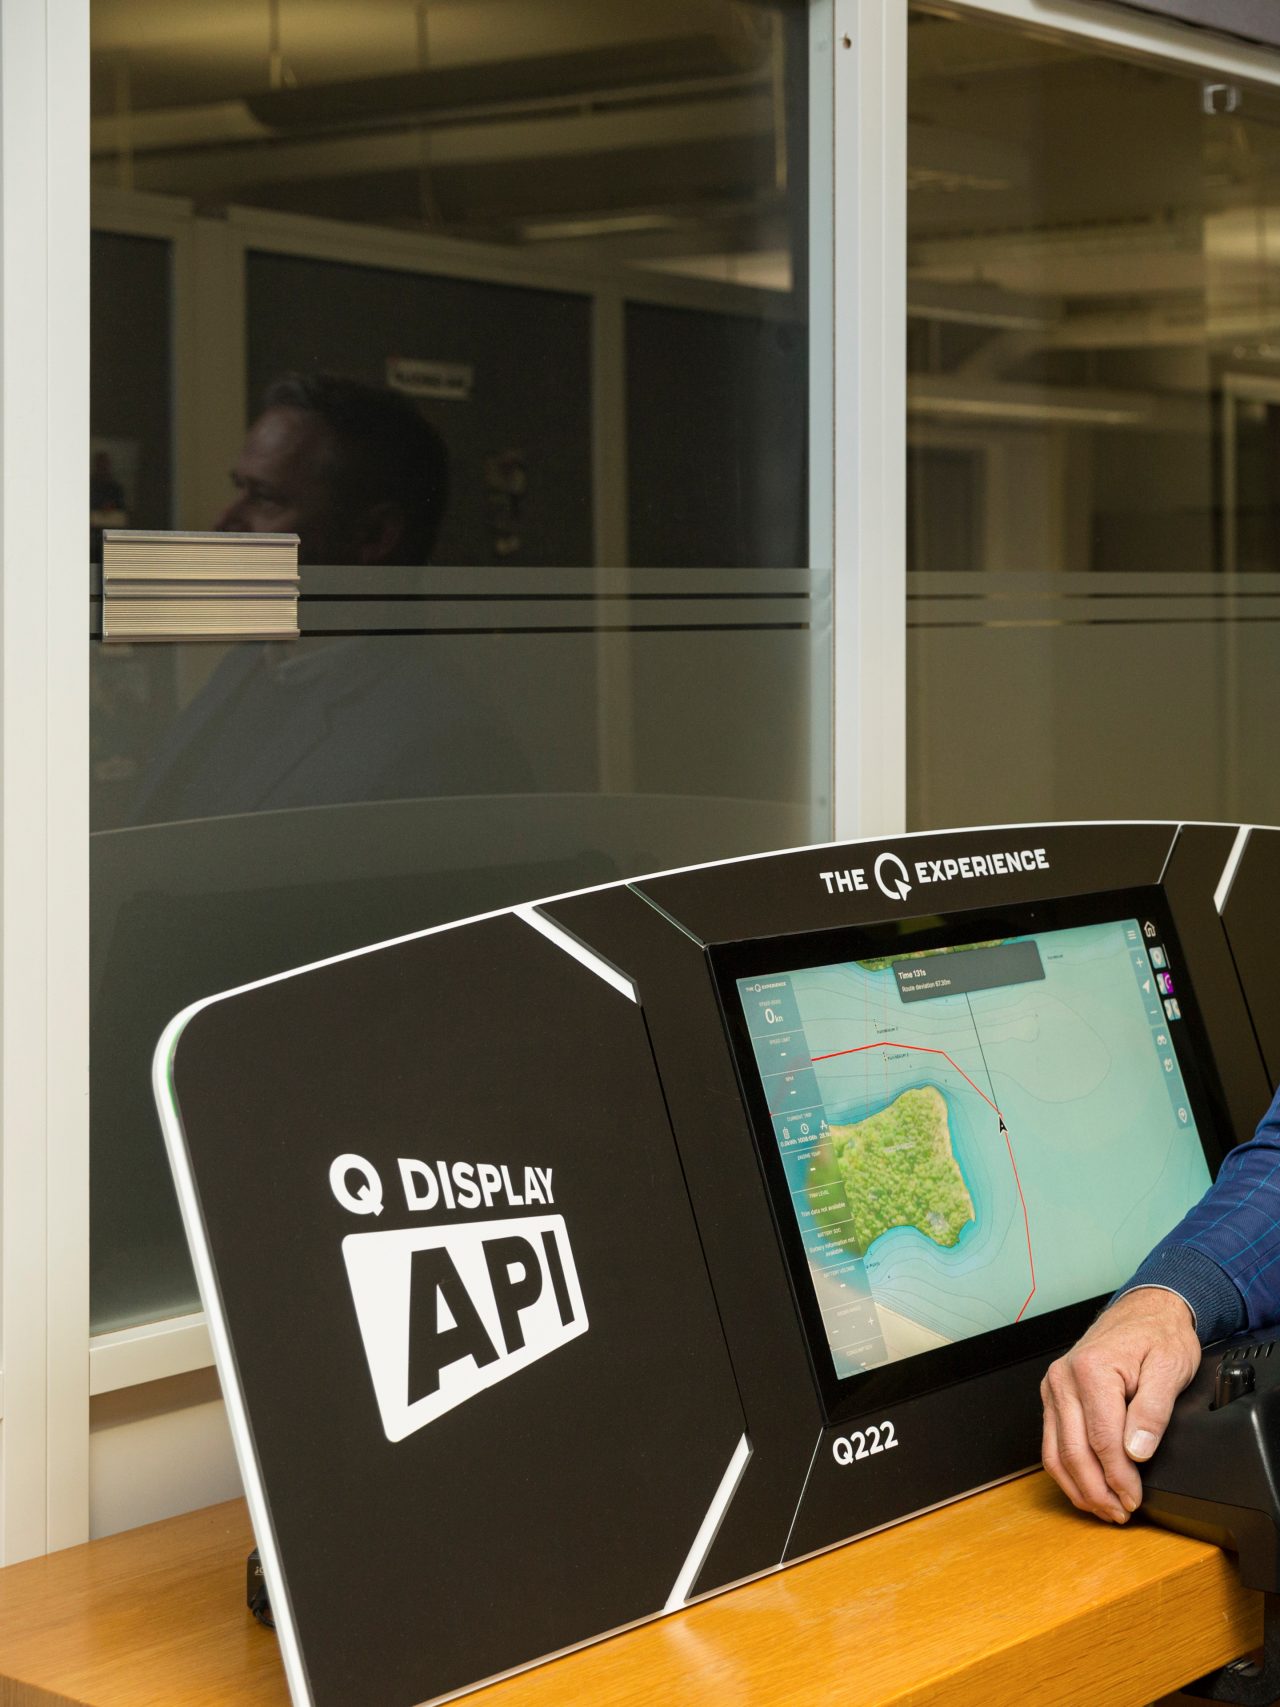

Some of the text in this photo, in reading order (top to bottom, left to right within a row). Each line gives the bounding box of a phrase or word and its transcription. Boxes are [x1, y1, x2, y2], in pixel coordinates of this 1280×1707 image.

[819, 848, 1050, 902] THE Q EXPERIENCE
[329, 1153, 555, 1216] Q DISPLAY
[407, 1230, 575, 1407] API
[832, 1420, 899, 1466] Q222
